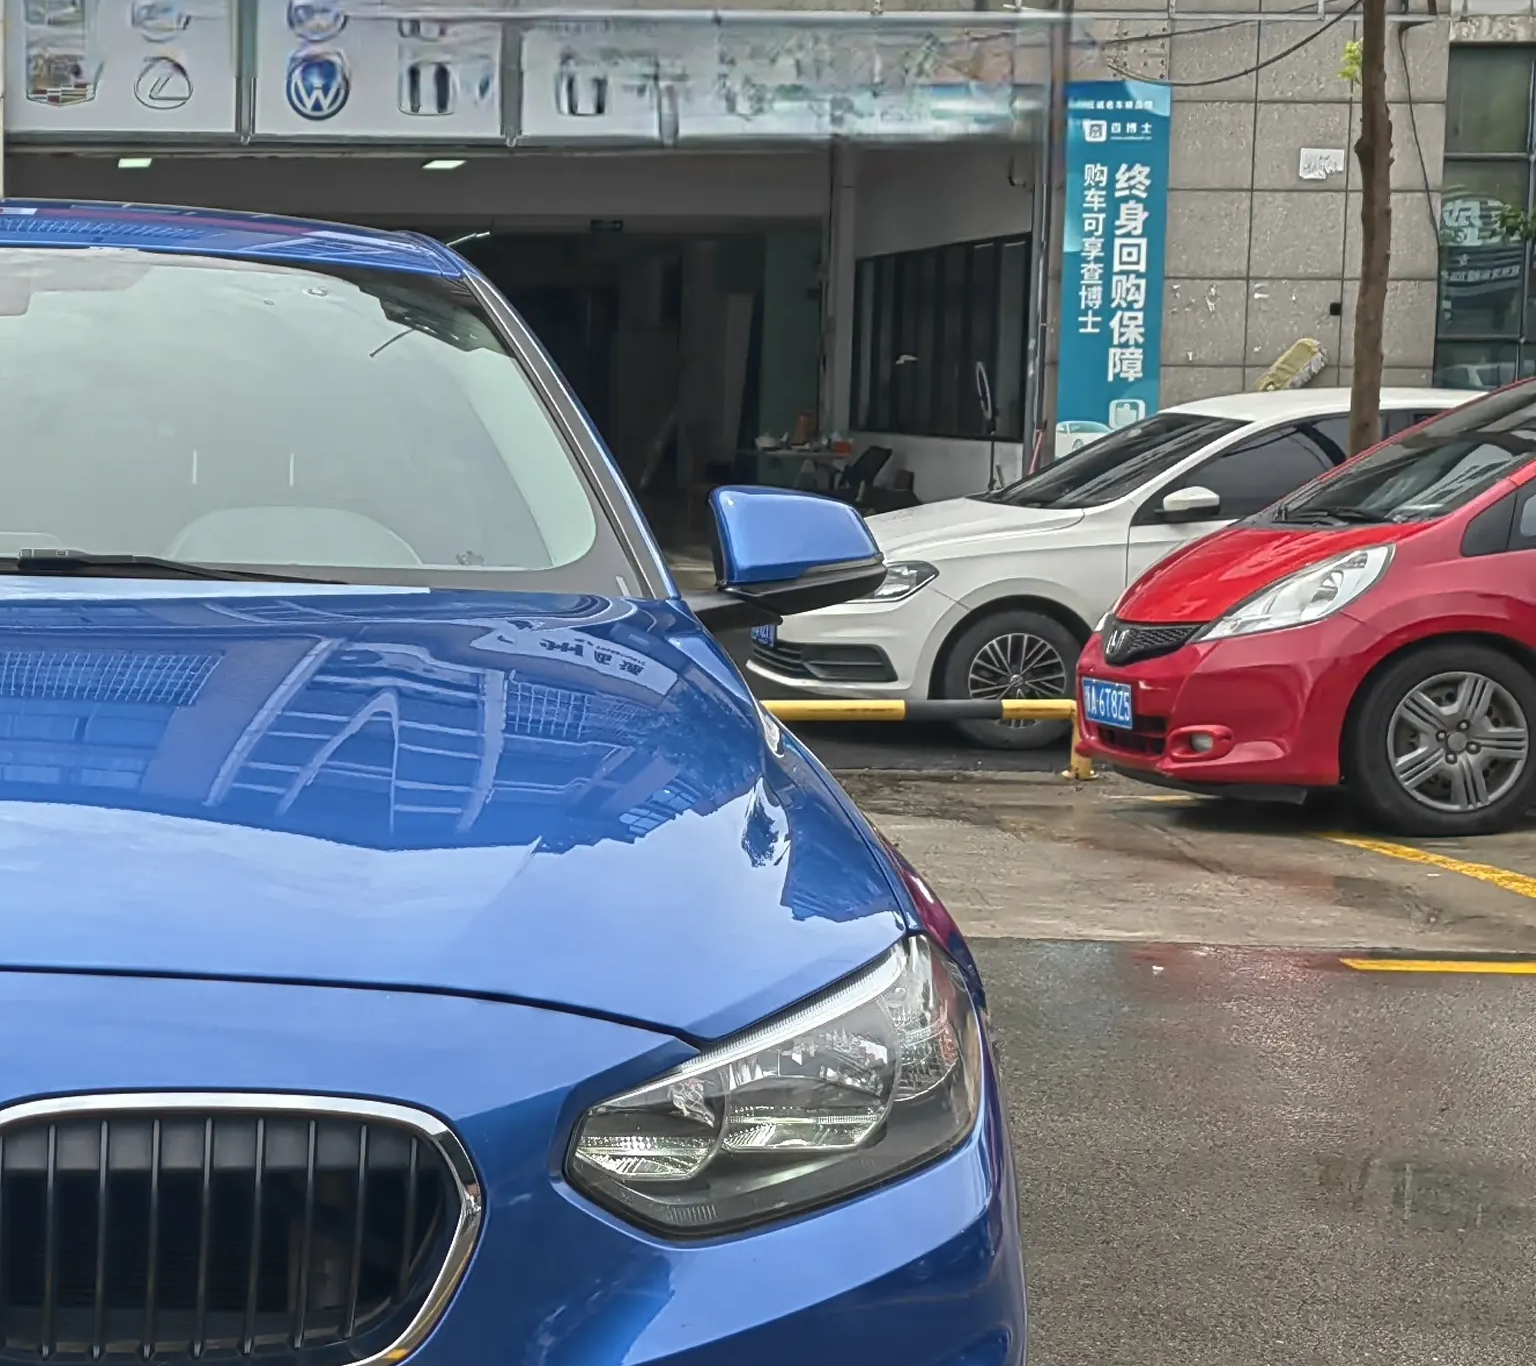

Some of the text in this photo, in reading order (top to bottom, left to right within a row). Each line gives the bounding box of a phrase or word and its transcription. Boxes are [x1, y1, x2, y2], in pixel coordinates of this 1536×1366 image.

[1078, 163, 1109, 334] 购车可享查博士
[1107, 162, 1152, 383] 终身回购保障
